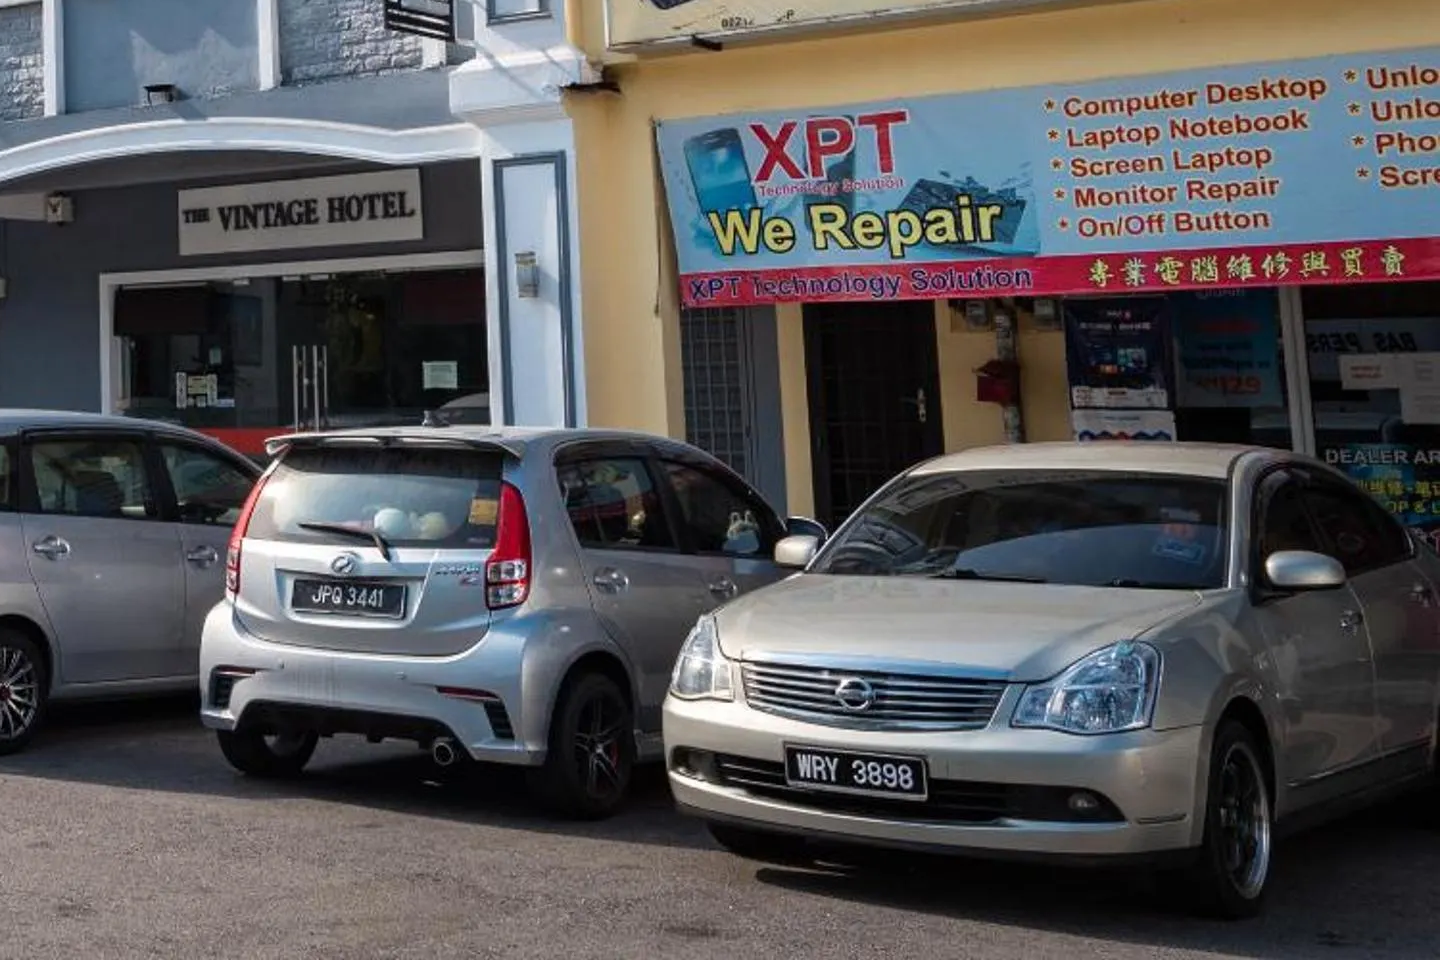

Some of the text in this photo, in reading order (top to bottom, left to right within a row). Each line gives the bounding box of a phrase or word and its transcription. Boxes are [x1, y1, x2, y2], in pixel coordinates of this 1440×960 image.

[1366, 65, 1440, 91] Unlo
[1063, 78, 1327, 118] Computer Desktop
[1371, 99, 1440, 123] Unlo
[748, 108, 908, 183] XPT
[1067, 108, 1309, 150] Laptop Notebook
[1070, 146, 1273, 178] Screen Laptop
[760, 176, 904, 198] Technology Solution
[1073, 175, 1280, 209] Monitor Repair
[182, 190, 416, 233] THE VINTAGE HOTEL
[707, 193, 1004, 259] We Repair
[1077, 209, 1270, 238] On/Off Button
[691, 266, 1033, 300] XPT Technology Solution
[1325, 449, 1409, 464] DEALER
[312, 585, 384, 608] JPQ 3441
[796, 752, 914, 790] WRY 3898
